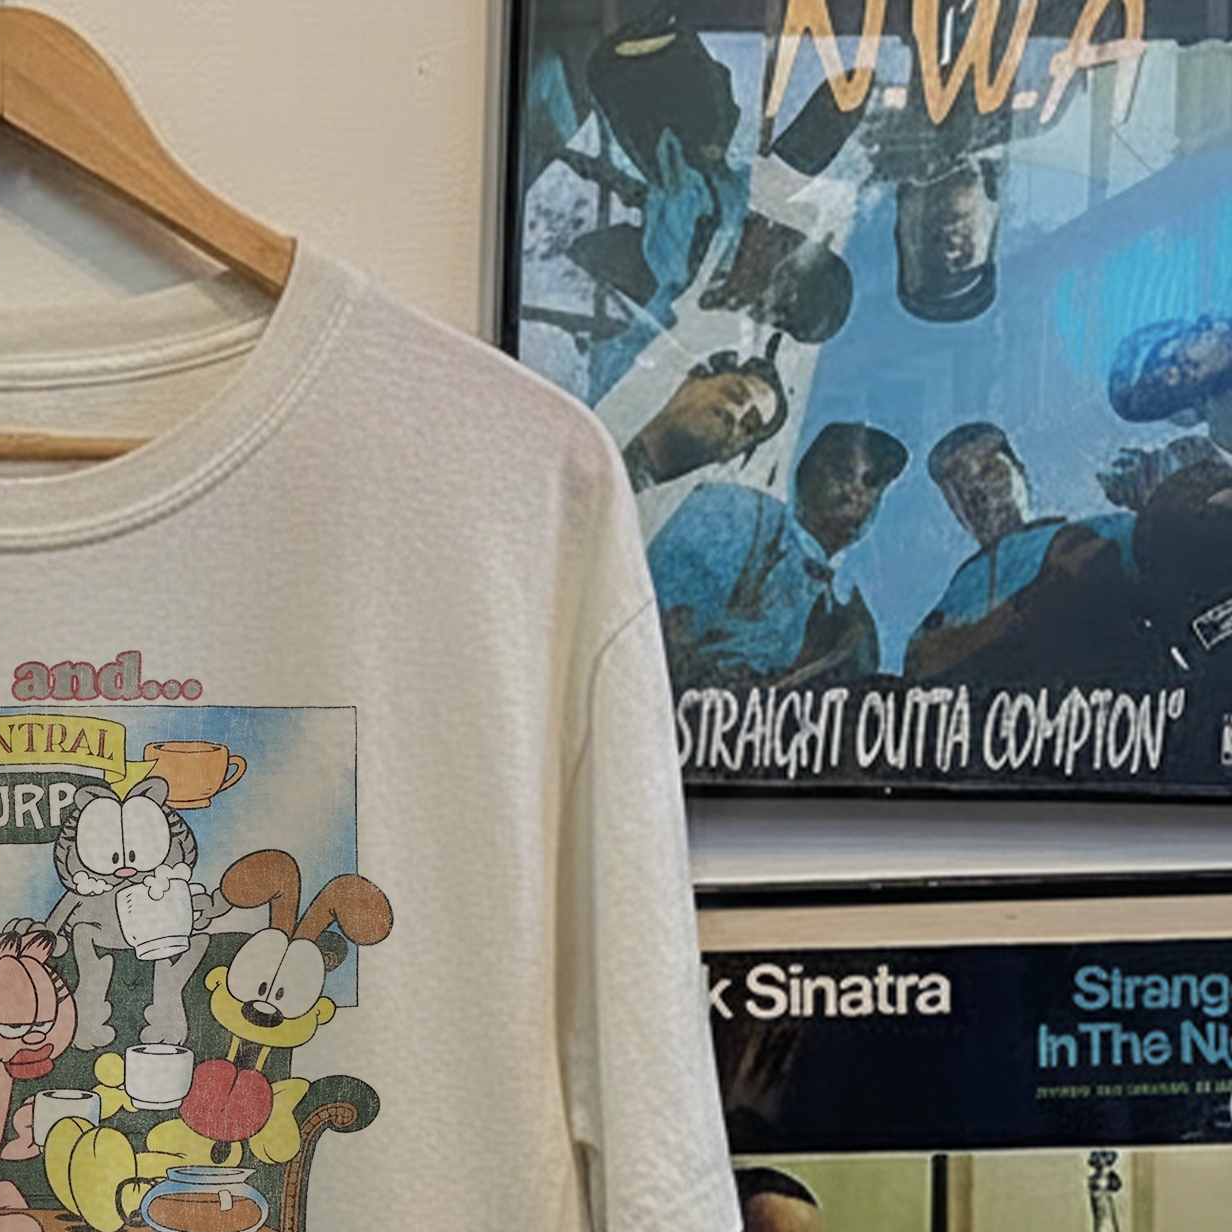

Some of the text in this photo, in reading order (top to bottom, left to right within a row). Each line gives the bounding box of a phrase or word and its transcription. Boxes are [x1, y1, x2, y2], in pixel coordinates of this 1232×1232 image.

[11, 650, 203, 701] and...
[678, 687, 849, 780] STRAIGHT
[856, 684, 970, 772] OUTTA
[745, 963, 951, 1020] Sinatra
[1072, 965, 1232, 1018] Strang
[1038, 1018, 1232, 1070] In The Ni
